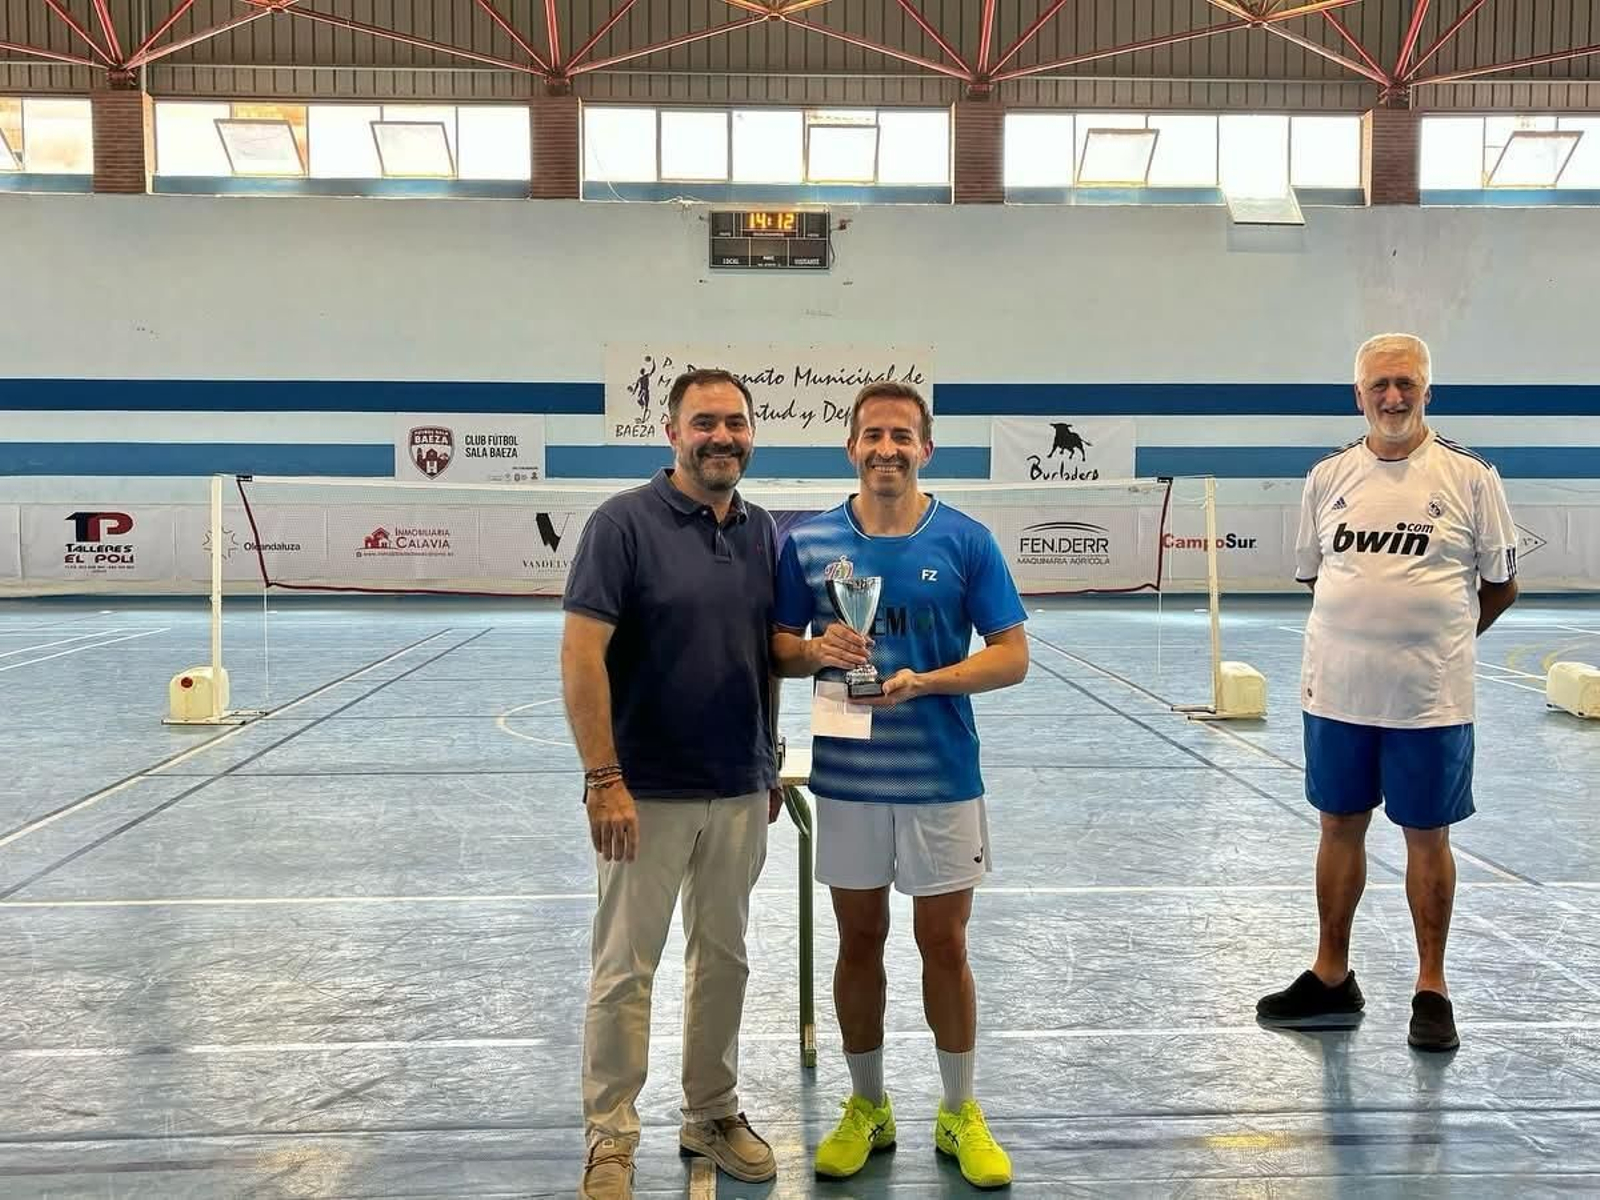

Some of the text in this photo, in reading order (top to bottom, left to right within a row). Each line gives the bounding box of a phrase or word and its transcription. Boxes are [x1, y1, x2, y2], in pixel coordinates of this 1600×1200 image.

[749, 212, 795, 230] 14:12
[901, 364, 925, 385] de
[799, 409, 817, 429] y
[615, 424, 656, 438] BAEZA
[414, 435, 449, 445] BAEZA
[464, 434, 487, 446] CLUB
[465, 447, 518, 459] SALA BAEZA
[395, 536, 450, 549] CALAVIA
[1332, 521, 1431, 557] bwin
[64, 543, 134, 554] TALLERES
[64, 554, 135, 564] EL POLI
[522, 559, 569, 569] VANDELV
[921, 568, 939, 582] FZ
